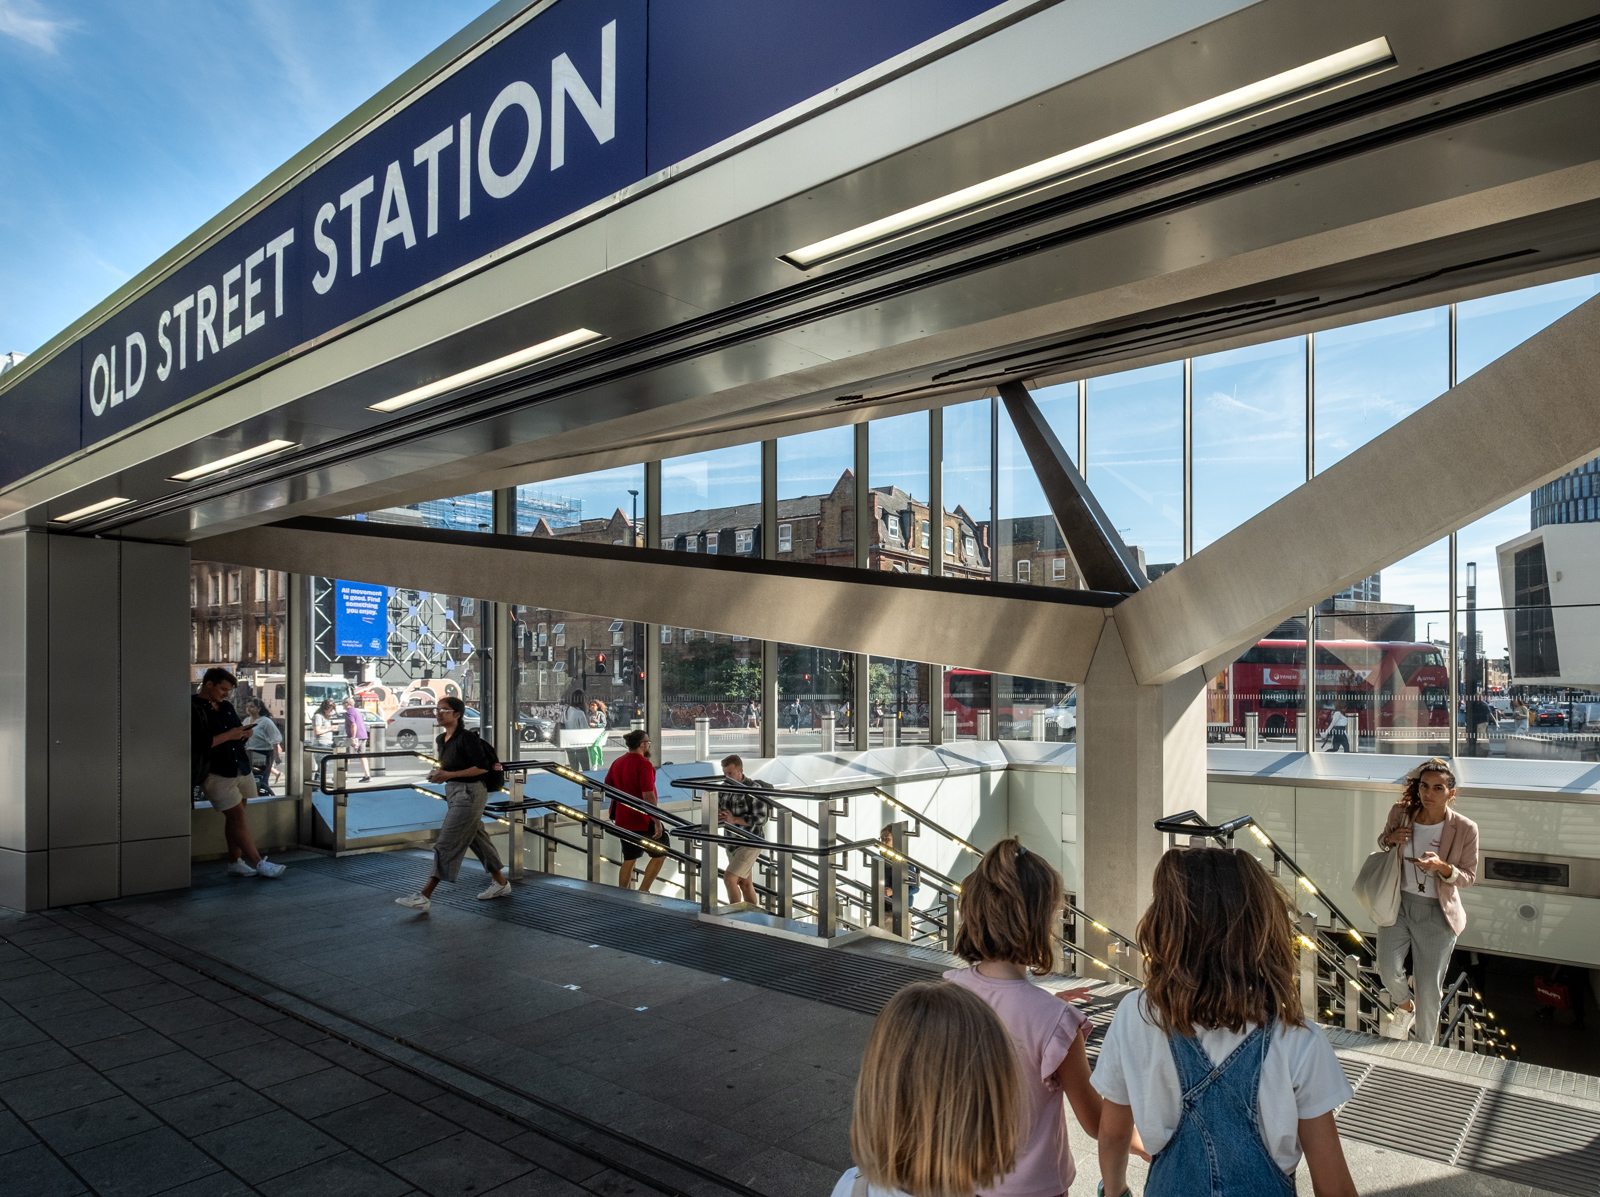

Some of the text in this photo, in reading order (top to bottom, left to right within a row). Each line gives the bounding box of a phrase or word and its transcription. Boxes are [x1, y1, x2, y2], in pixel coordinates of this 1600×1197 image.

[89, 18, 617, 417] OLD STREET STATION
[350, 588, 382, 597] movement
[345, 601, 378, 609] something
